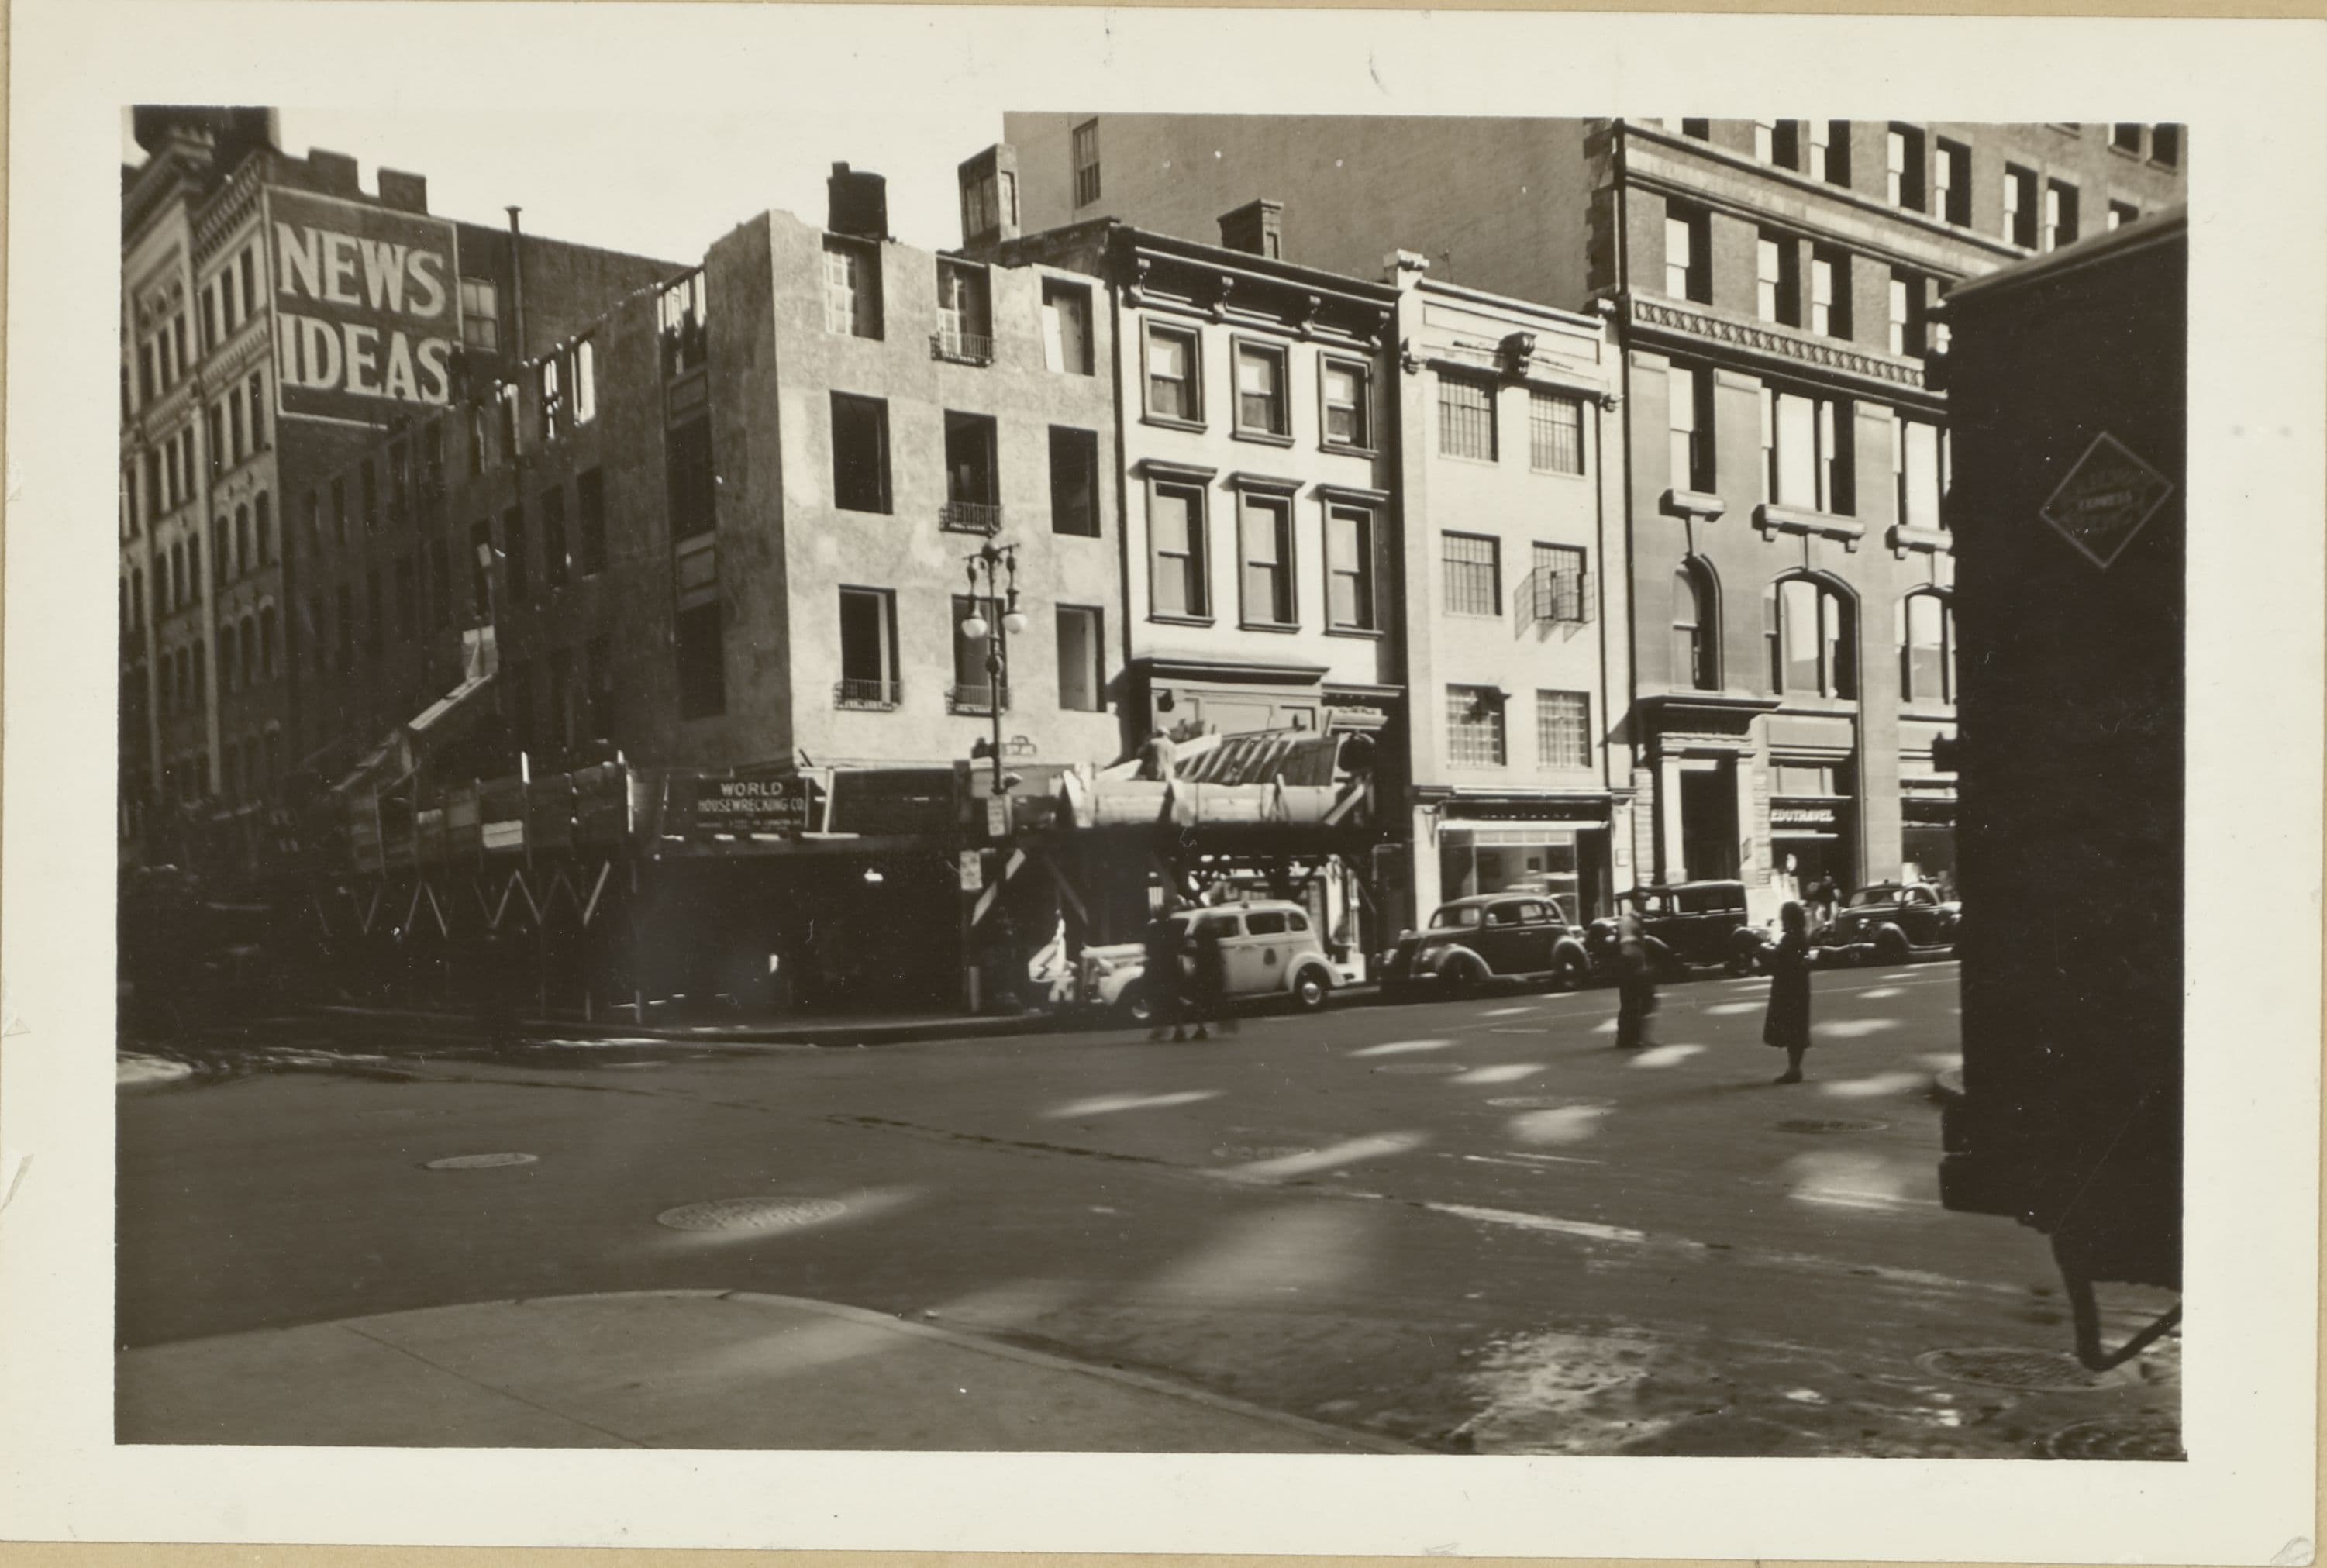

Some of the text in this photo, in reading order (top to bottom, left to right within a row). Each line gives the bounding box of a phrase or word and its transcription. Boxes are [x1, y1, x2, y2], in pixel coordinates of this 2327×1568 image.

[274, 221, 446, 318] NEWS
[277, 312, 452, 405] IDEAS
[698, 798, 788, 812] HOUSEWRECKING
[720, 782, 783, 796] WORLD
